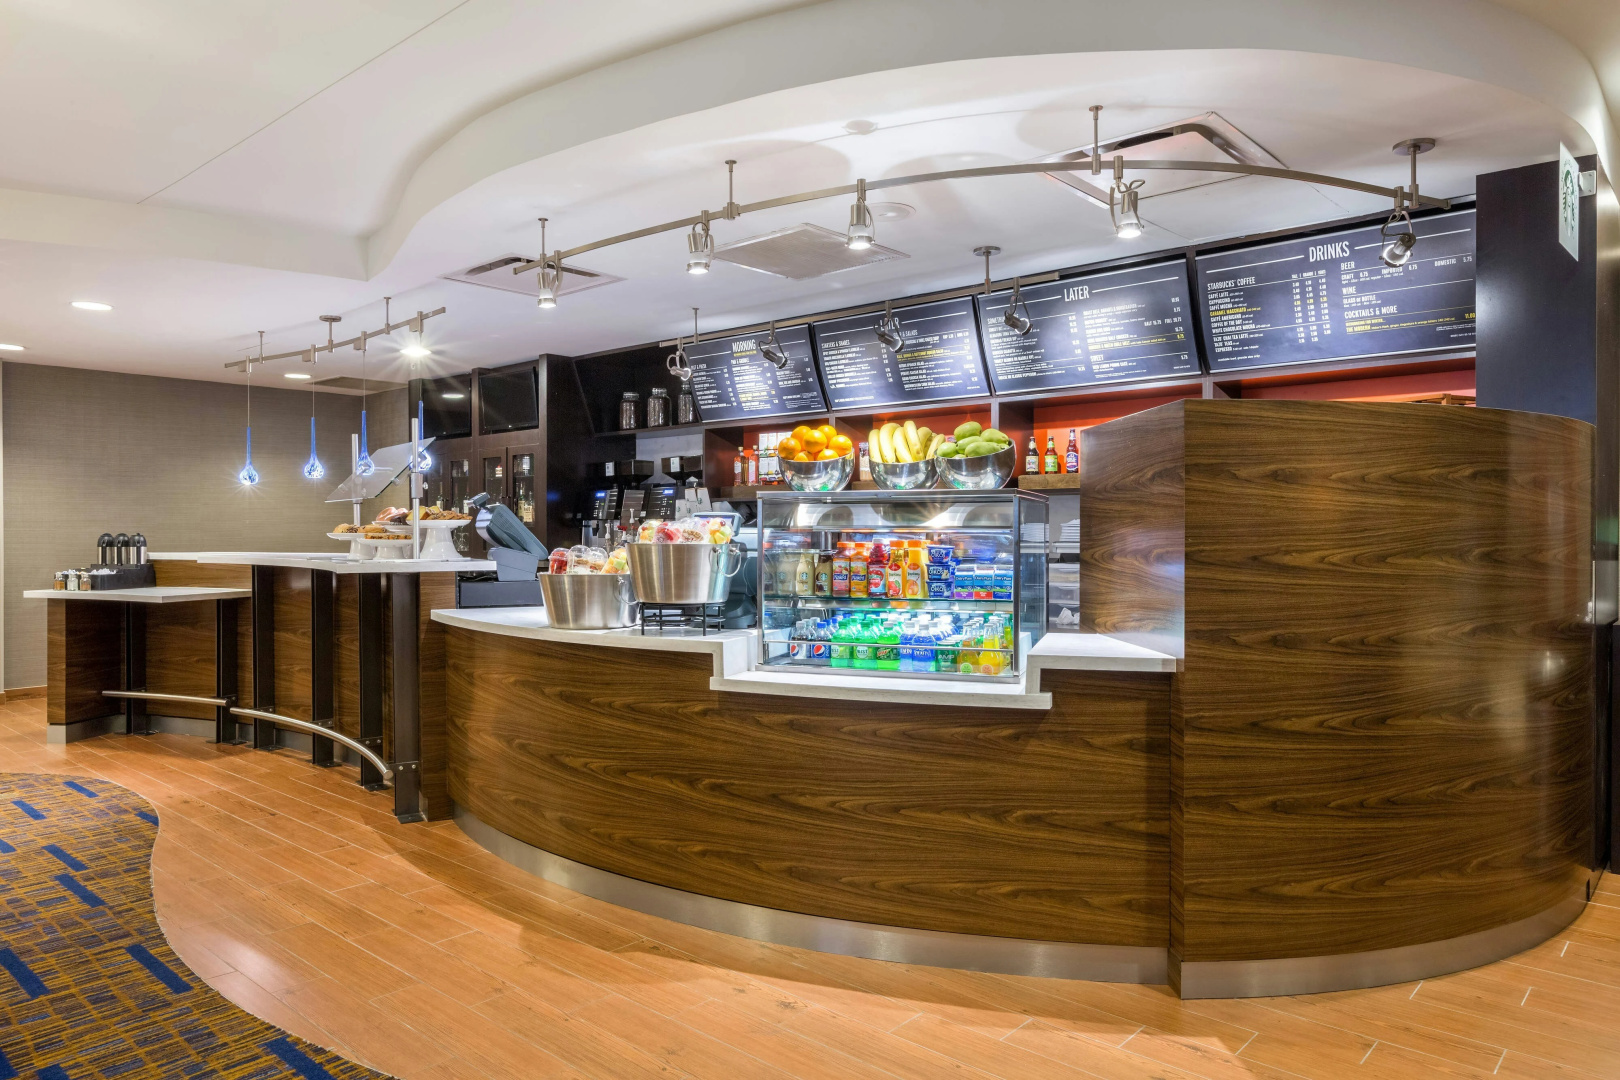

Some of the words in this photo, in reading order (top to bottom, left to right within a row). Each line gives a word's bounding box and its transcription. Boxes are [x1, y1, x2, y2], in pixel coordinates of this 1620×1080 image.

[1309, 241, 1350, 262] DRINKS
[1341, 261, 1355, 270] BEER
[1434, 258, 1457, 267] DOMESTIC
[1237, 276, 1256, 286] COFFEE
[1064, 285, 1090, 302] LATER
[1344, 307, 1374, 319] COCKTAILS
[1381, 305, 1398, 315] MORE
[732, 339, 757, 353] MORNING
